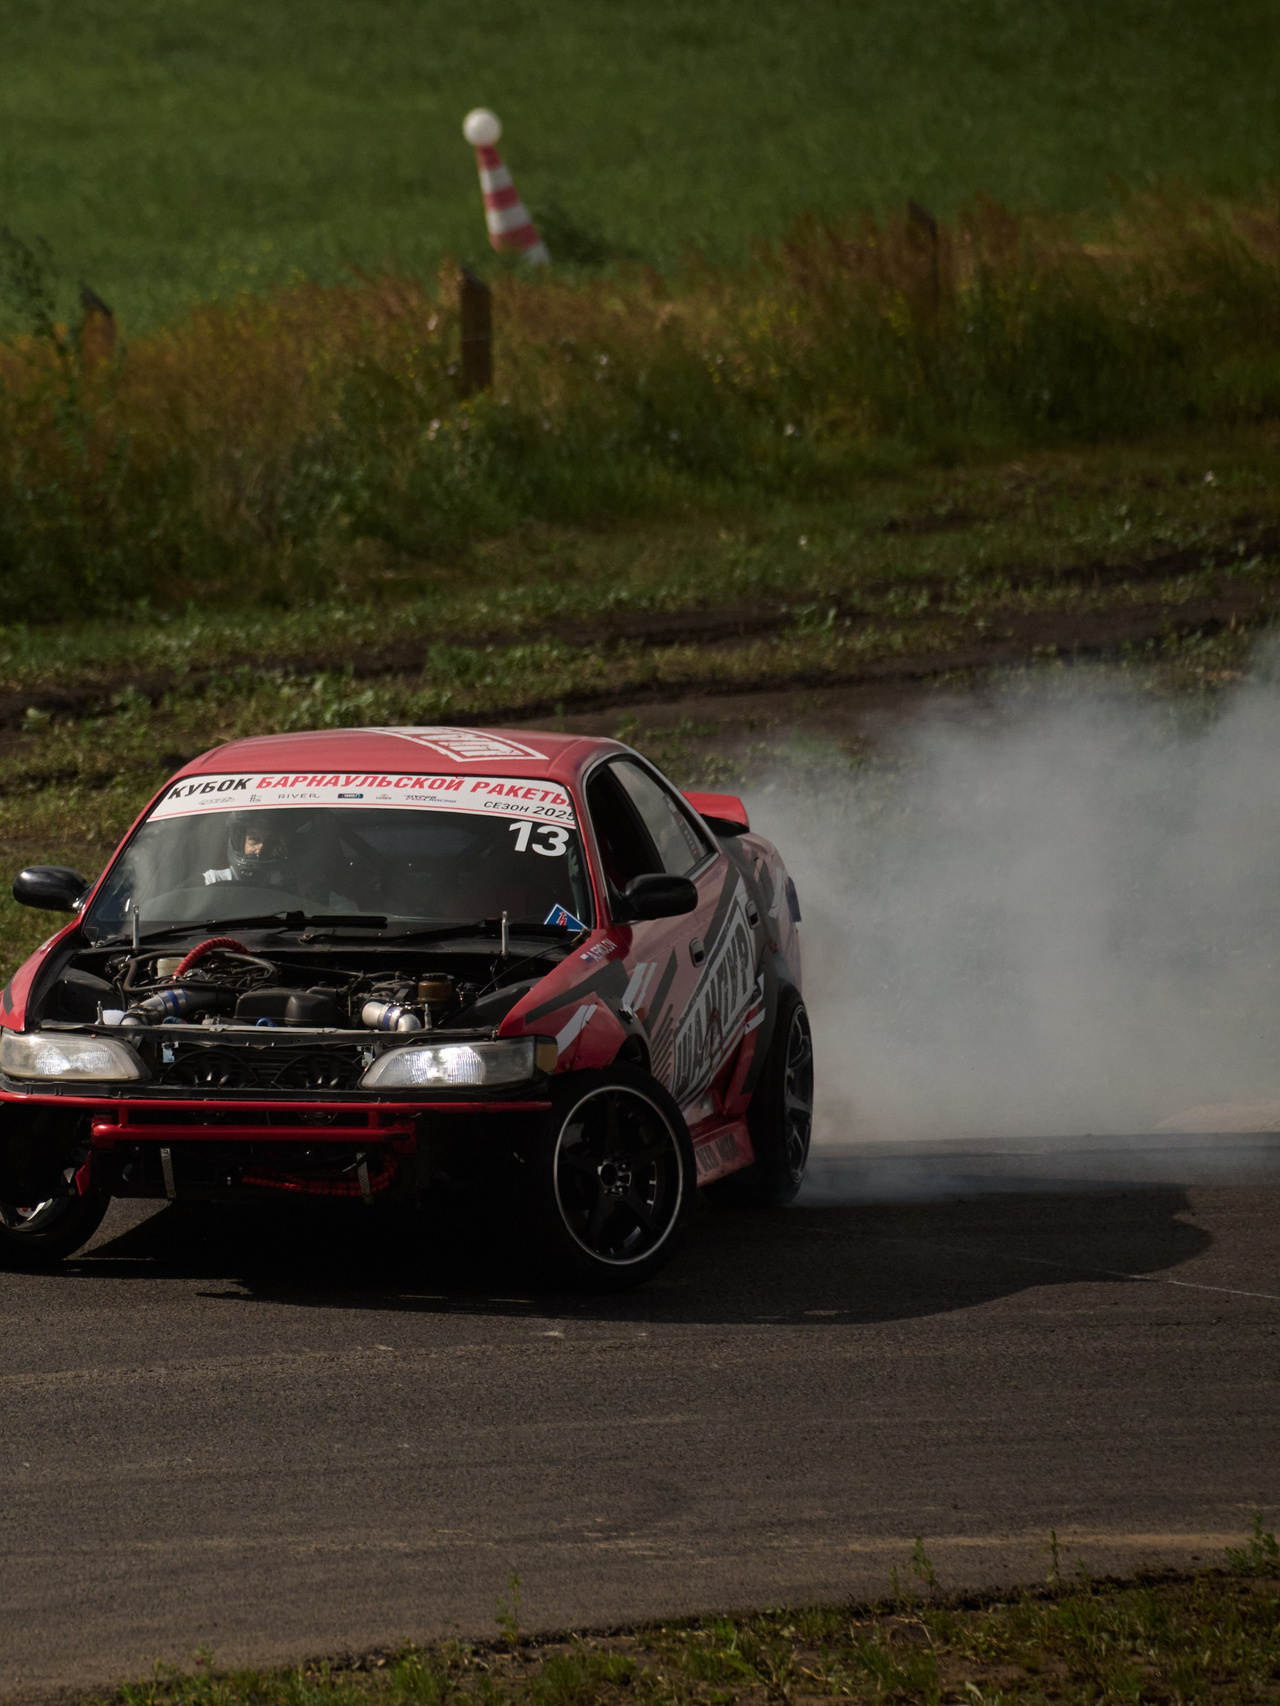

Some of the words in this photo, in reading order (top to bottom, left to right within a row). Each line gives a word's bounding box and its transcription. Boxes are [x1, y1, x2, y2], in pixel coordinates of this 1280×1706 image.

[168, 777, 253, 800] КУБОК
[256, 775, 465, 791] БАРНАУЛЬСКОЙ
[484, 801, 529, 813] СЕЗОН
[533, 806, 575, 821] 2025
[509, 821, 569, 857] 13
